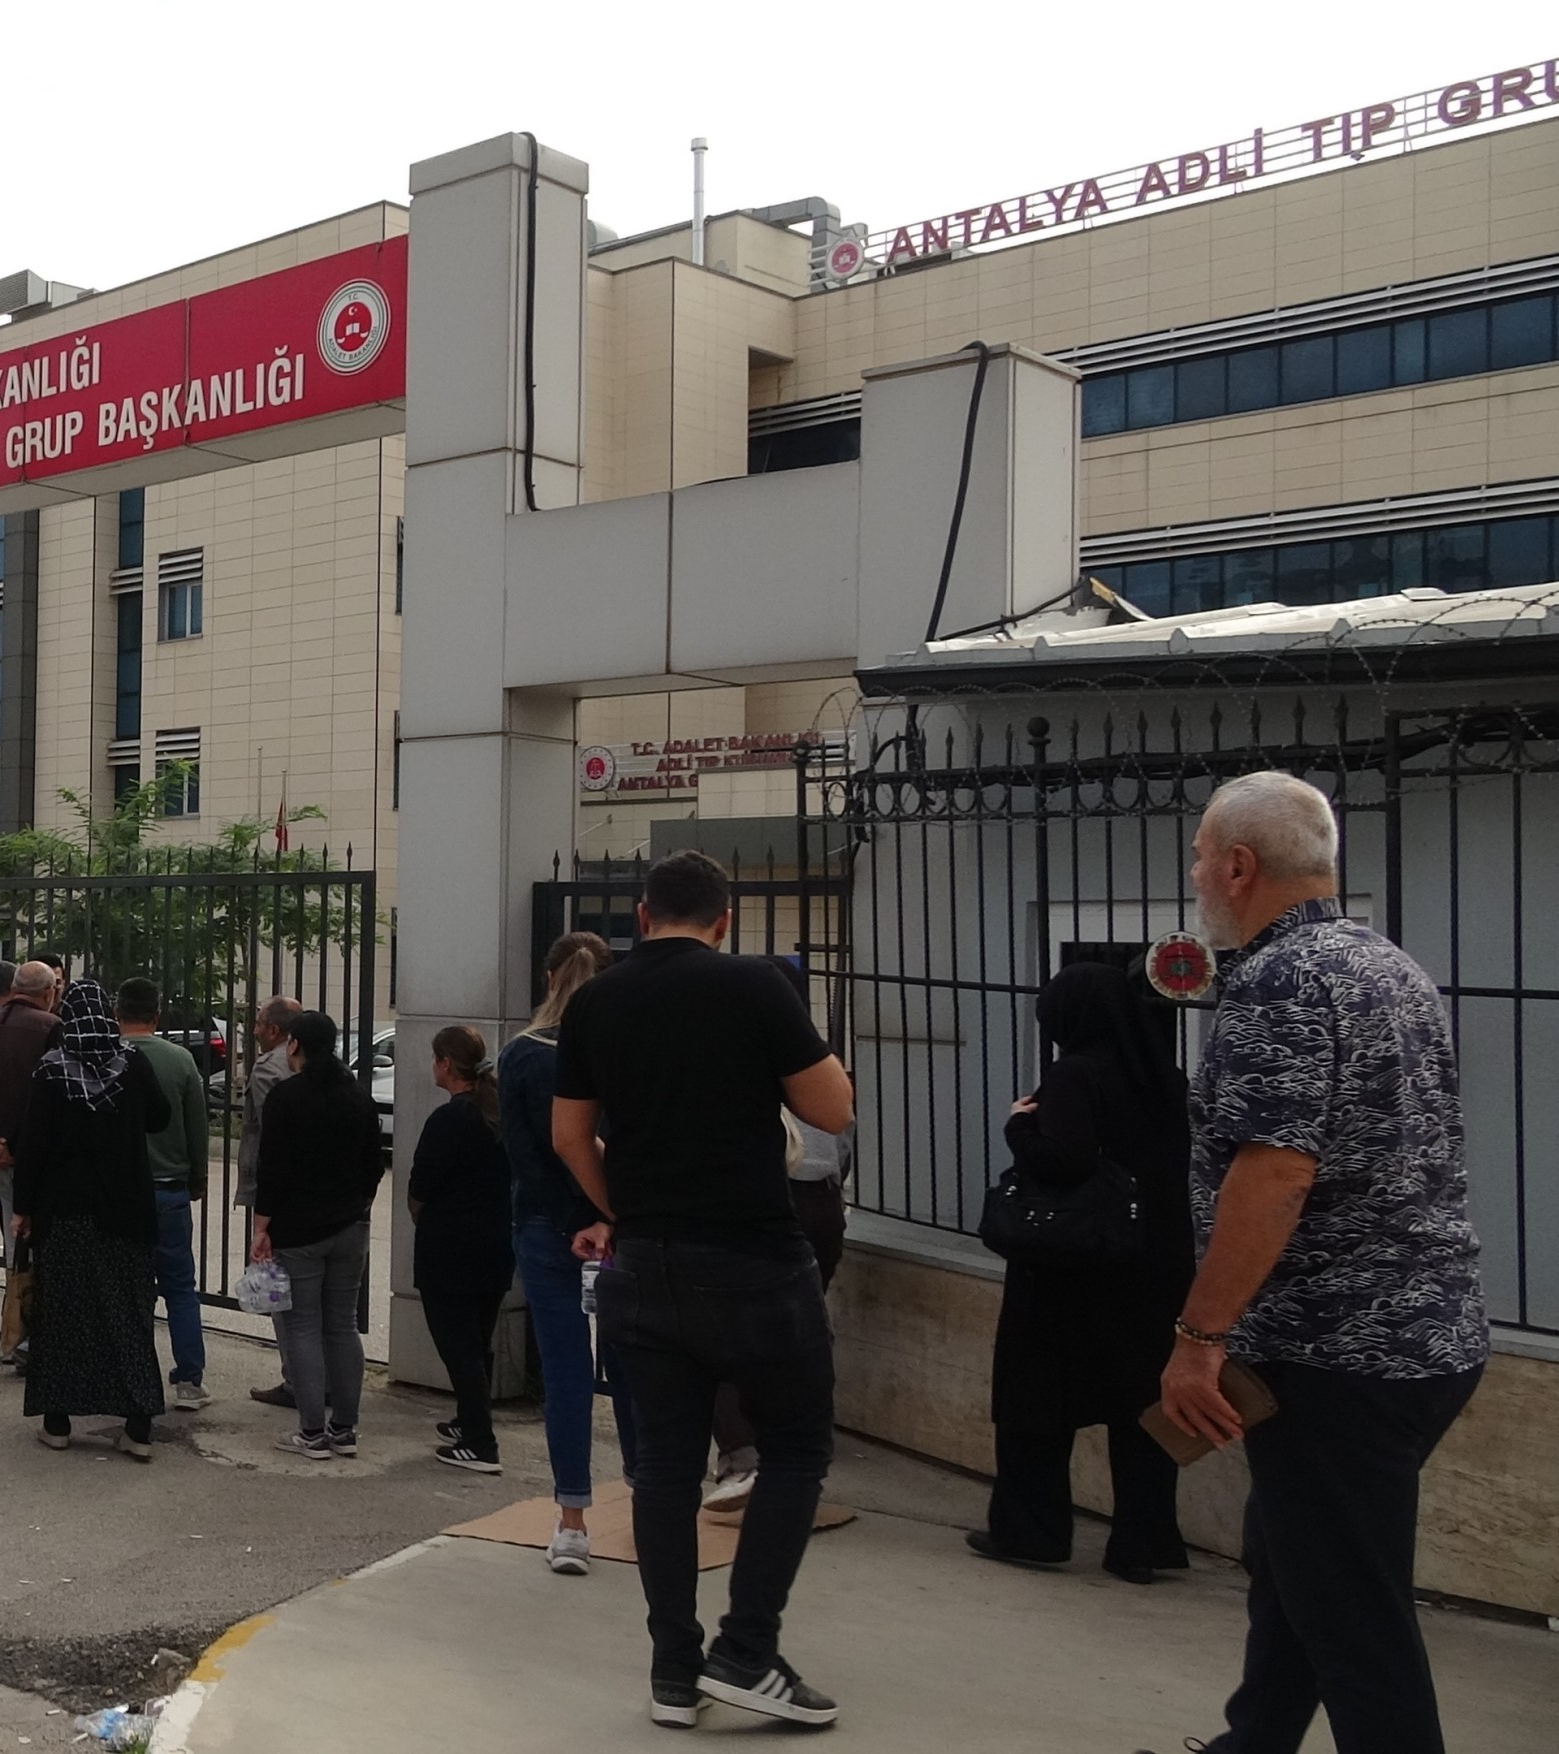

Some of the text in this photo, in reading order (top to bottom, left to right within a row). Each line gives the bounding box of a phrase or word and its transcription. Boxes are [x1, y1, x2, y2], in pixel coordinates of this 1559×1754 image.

[887, 179, 1108, 268] ANTALYA
[1136, 128, 1265, 205] ADLİ
[1301, 102, 1397, 163] TIP
[6, 410, 84, 469] GRUP
[98, 344, 305, 449] BAŞKANLIĞI
[662, 737, 724, 754] ADALET
[656, 754, 692, 772] ADLİ
[617, 775, 688, 791] ANTALYA
